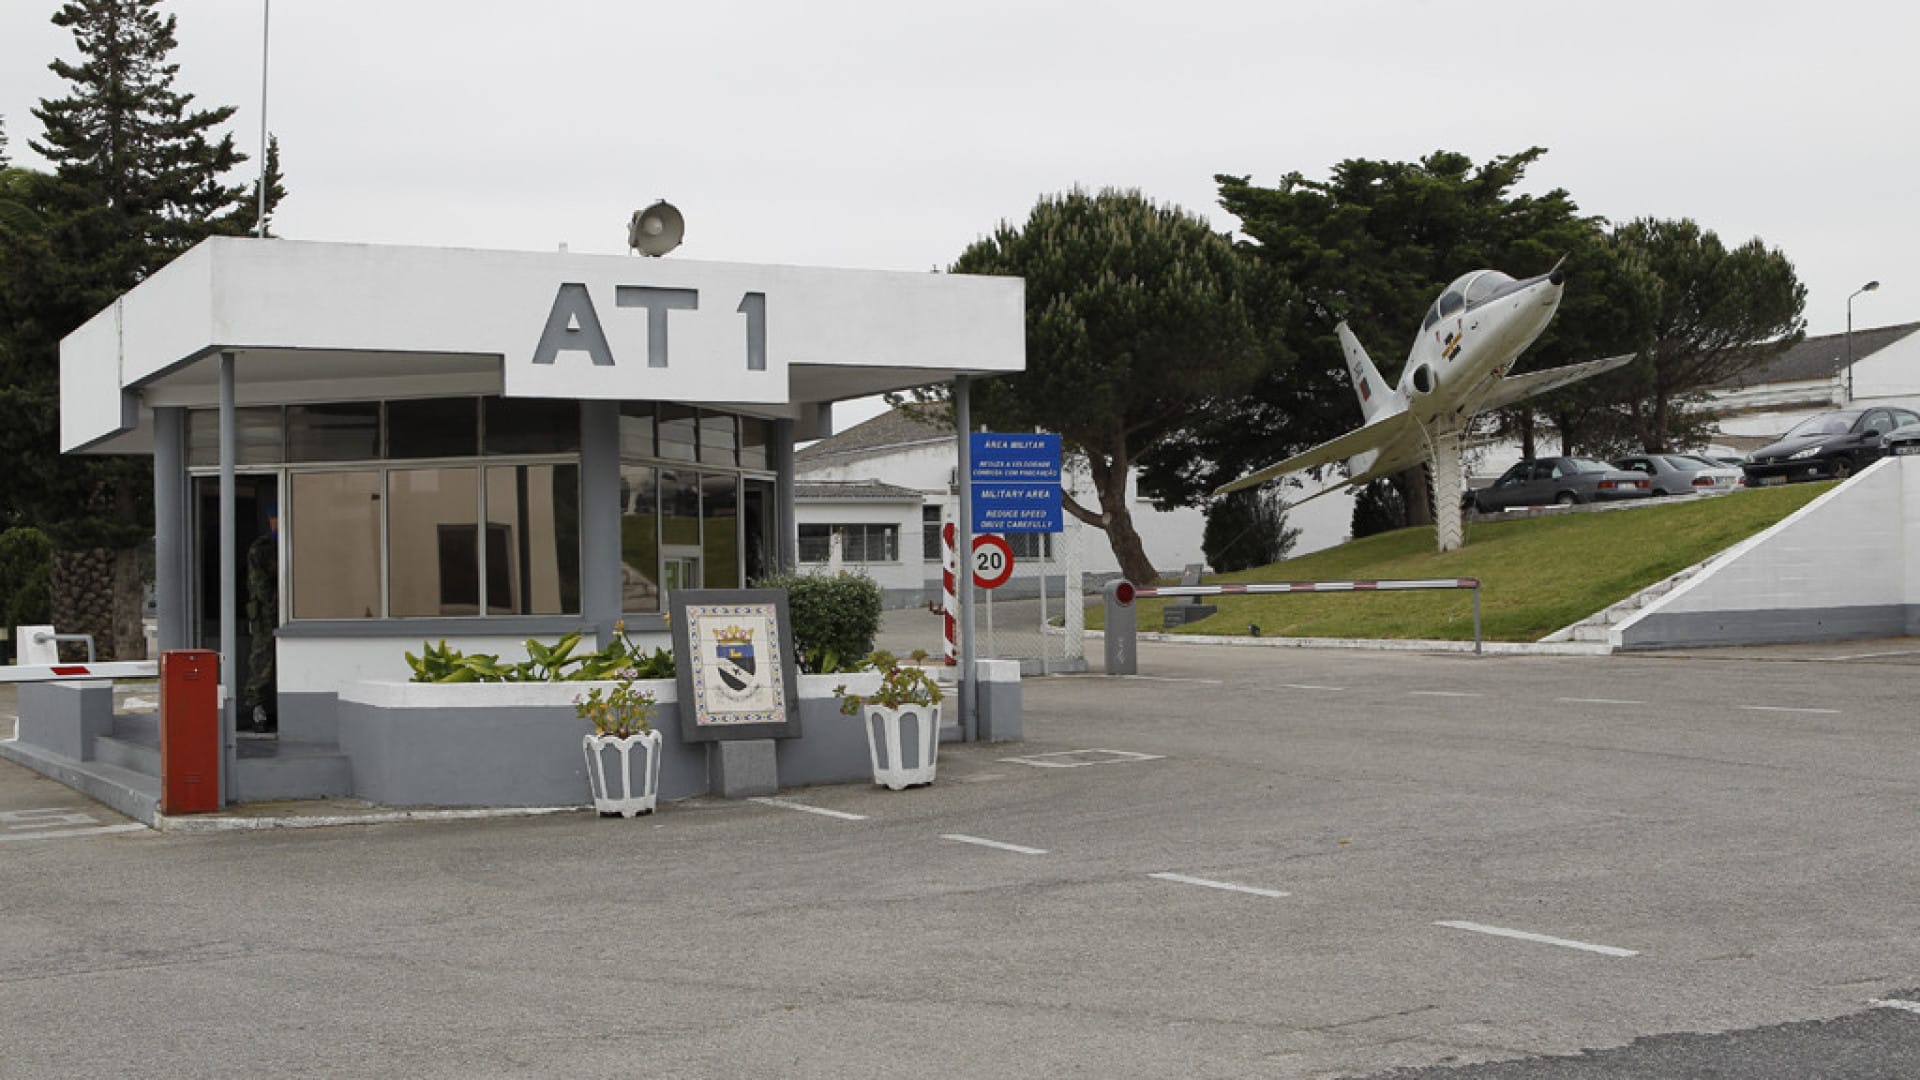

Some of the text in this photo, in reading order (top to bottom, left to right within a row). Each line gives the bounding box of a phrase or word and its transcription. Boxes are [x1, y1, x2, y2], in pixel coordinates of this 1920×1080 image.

[531, 282, 767, 371] AT 1
[1010, 441, 1046, 449] MILITAR
[982, 490, 1050, 499] MILITARY AREA
[986, 510, 1047, 518] REDUCE SPEED
[977, 552, 1002, 571] 20
